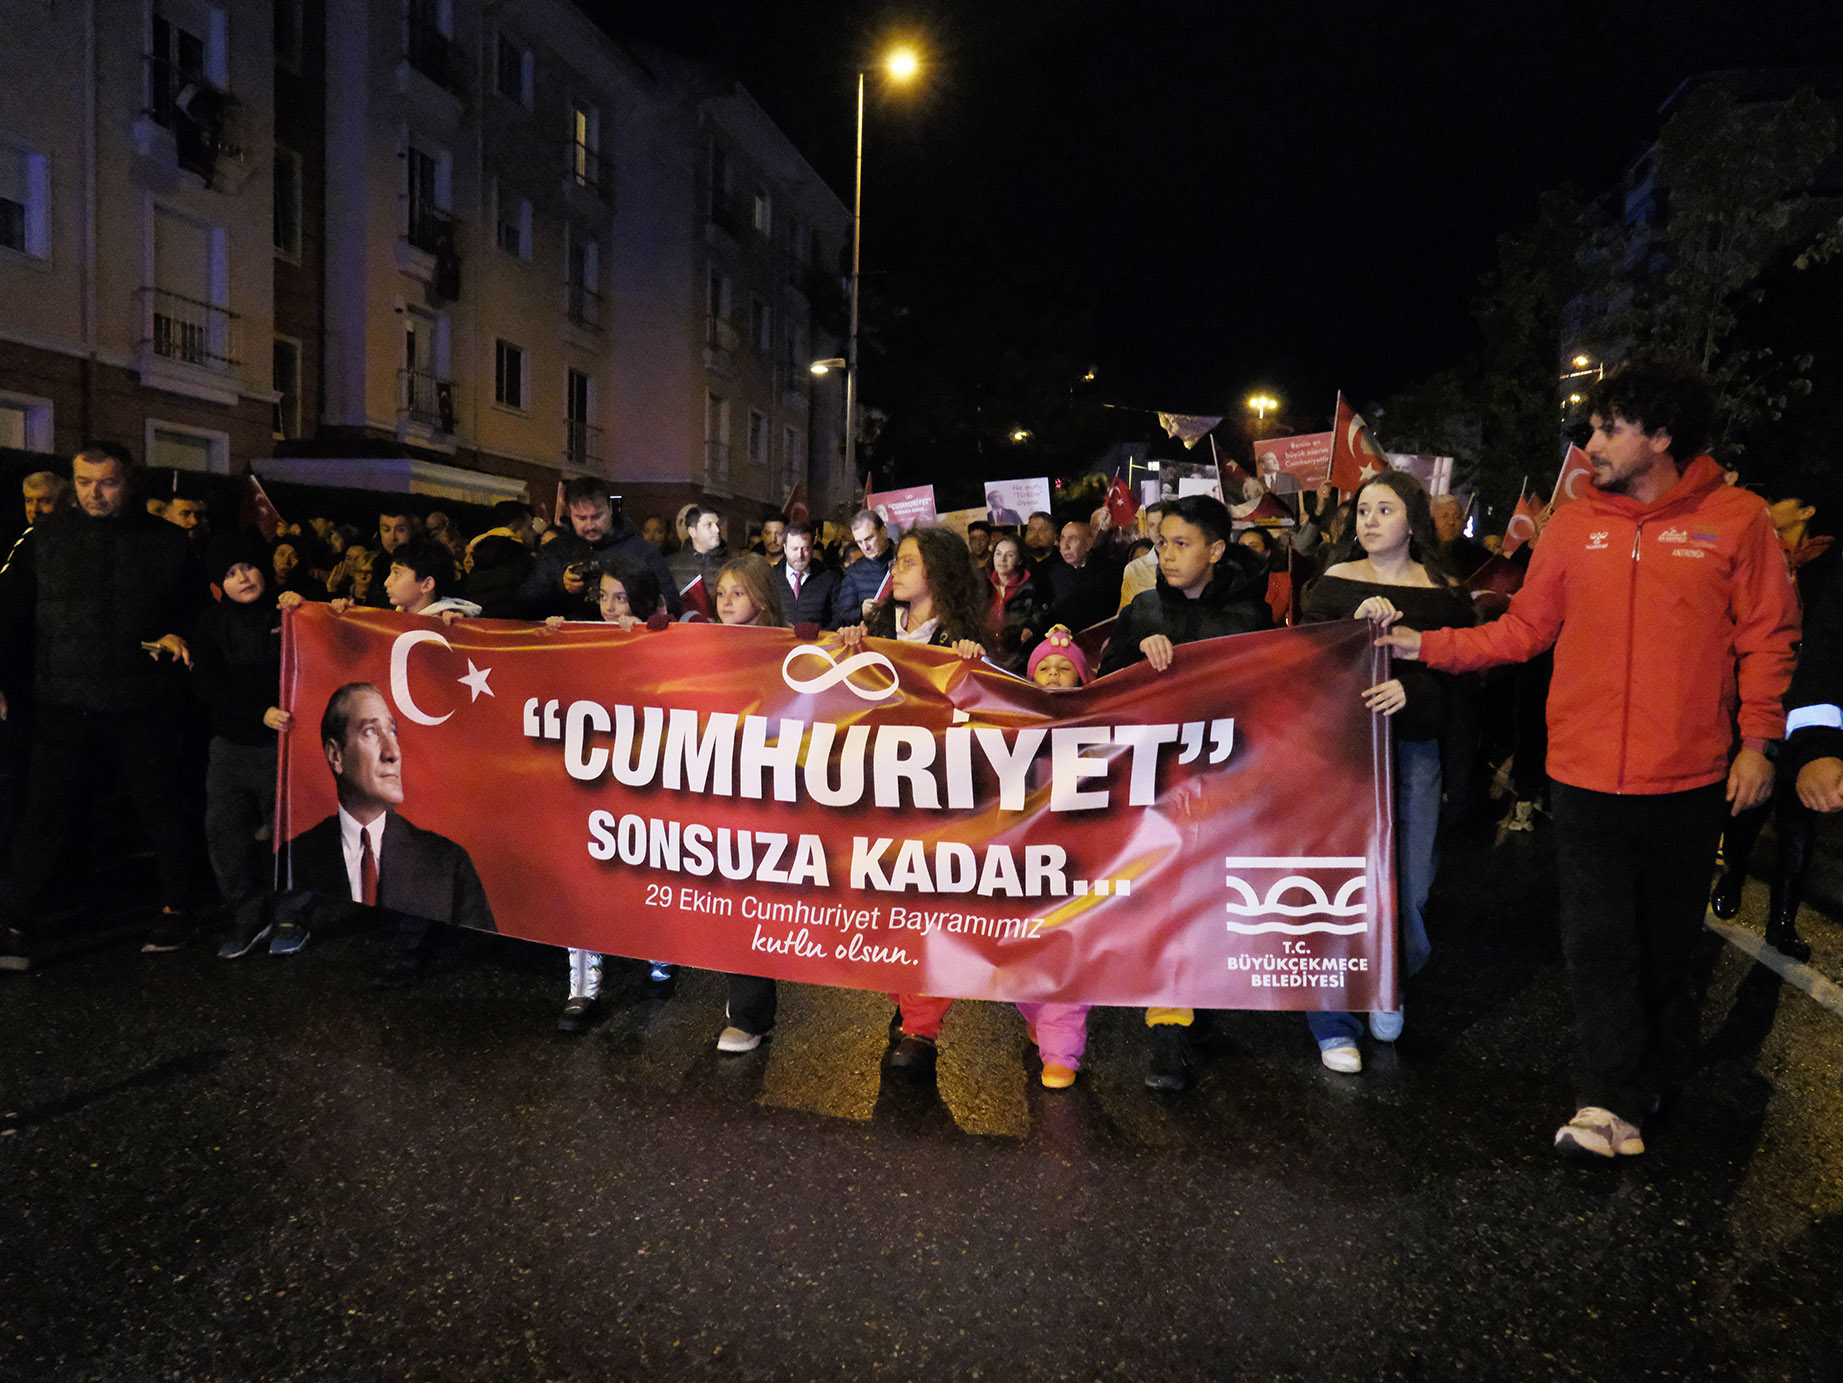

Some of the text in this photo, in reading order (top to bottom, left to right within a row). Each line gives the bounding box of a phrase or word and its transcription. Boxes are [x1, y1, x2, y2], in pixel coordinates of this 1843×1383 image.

[587, 809, 1131, 899] SONSUZA KADAR...
[644, 883, 1045, 939] 29 Ekim Cumhuriyet Bayramımız
[751, 923, 919, 966] kutlu olsun.
[1282, 941, 1311, 954] T.C.
[1227, 954, 1369, 975] BÜYÜKÇEKMECE
[1251, 972, 1345, 988] BELEDİYESİ
